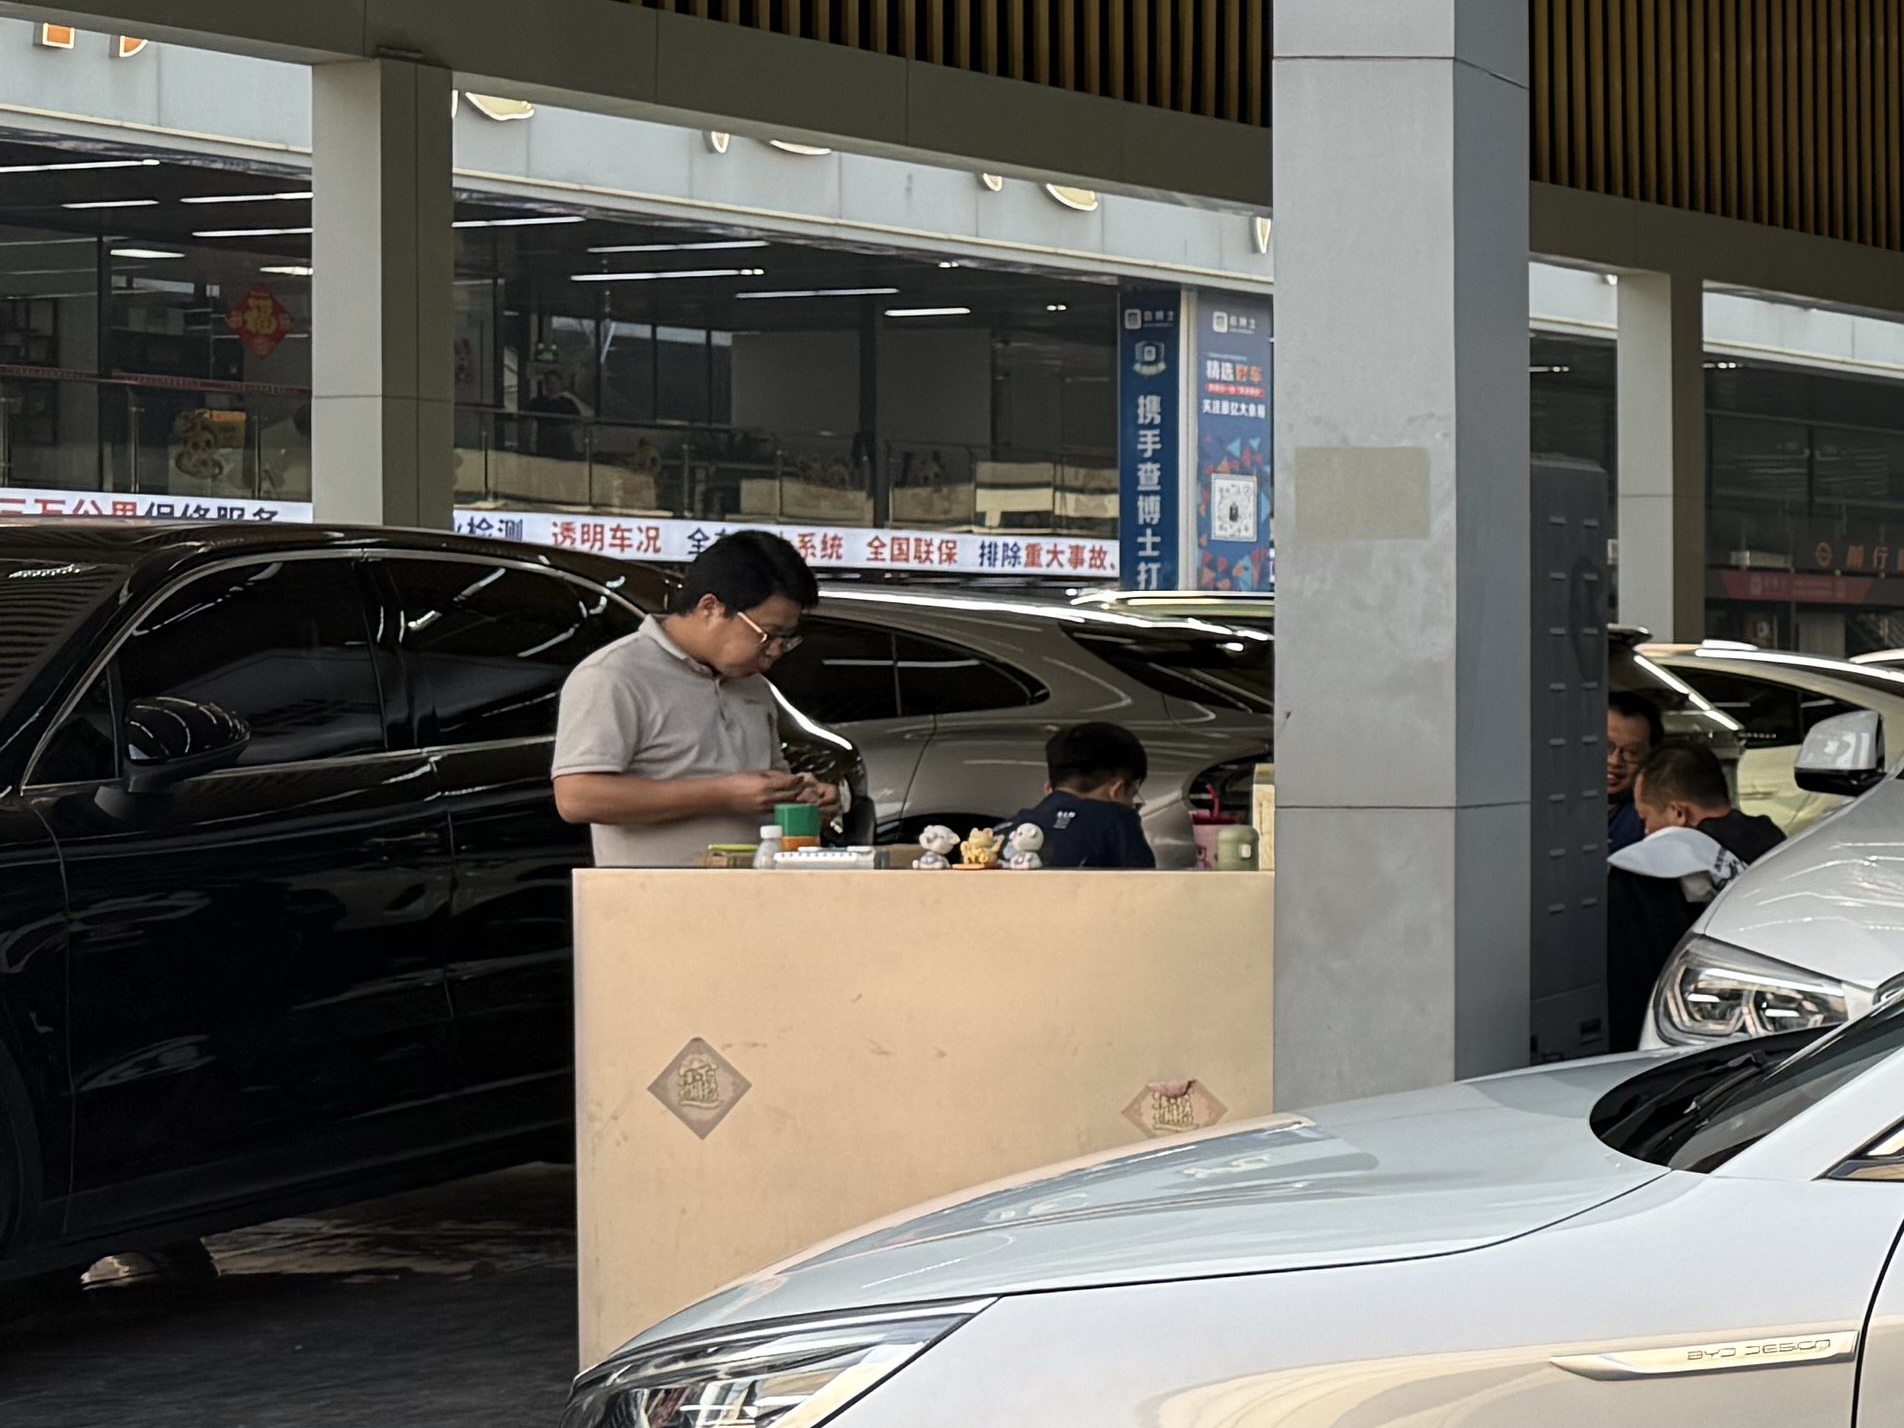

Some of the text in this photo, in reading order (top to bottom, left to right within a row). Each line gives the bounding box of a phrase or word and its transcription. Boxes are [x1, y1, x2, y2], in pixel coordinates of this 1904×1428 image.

[1136, 394, 1163, 591] 携手查博士打
[551, 520, 662, 555] 透明车况
[866, 535, 958, 565] 全国联保
[1687, 1347, 1737, 1361] BYD
